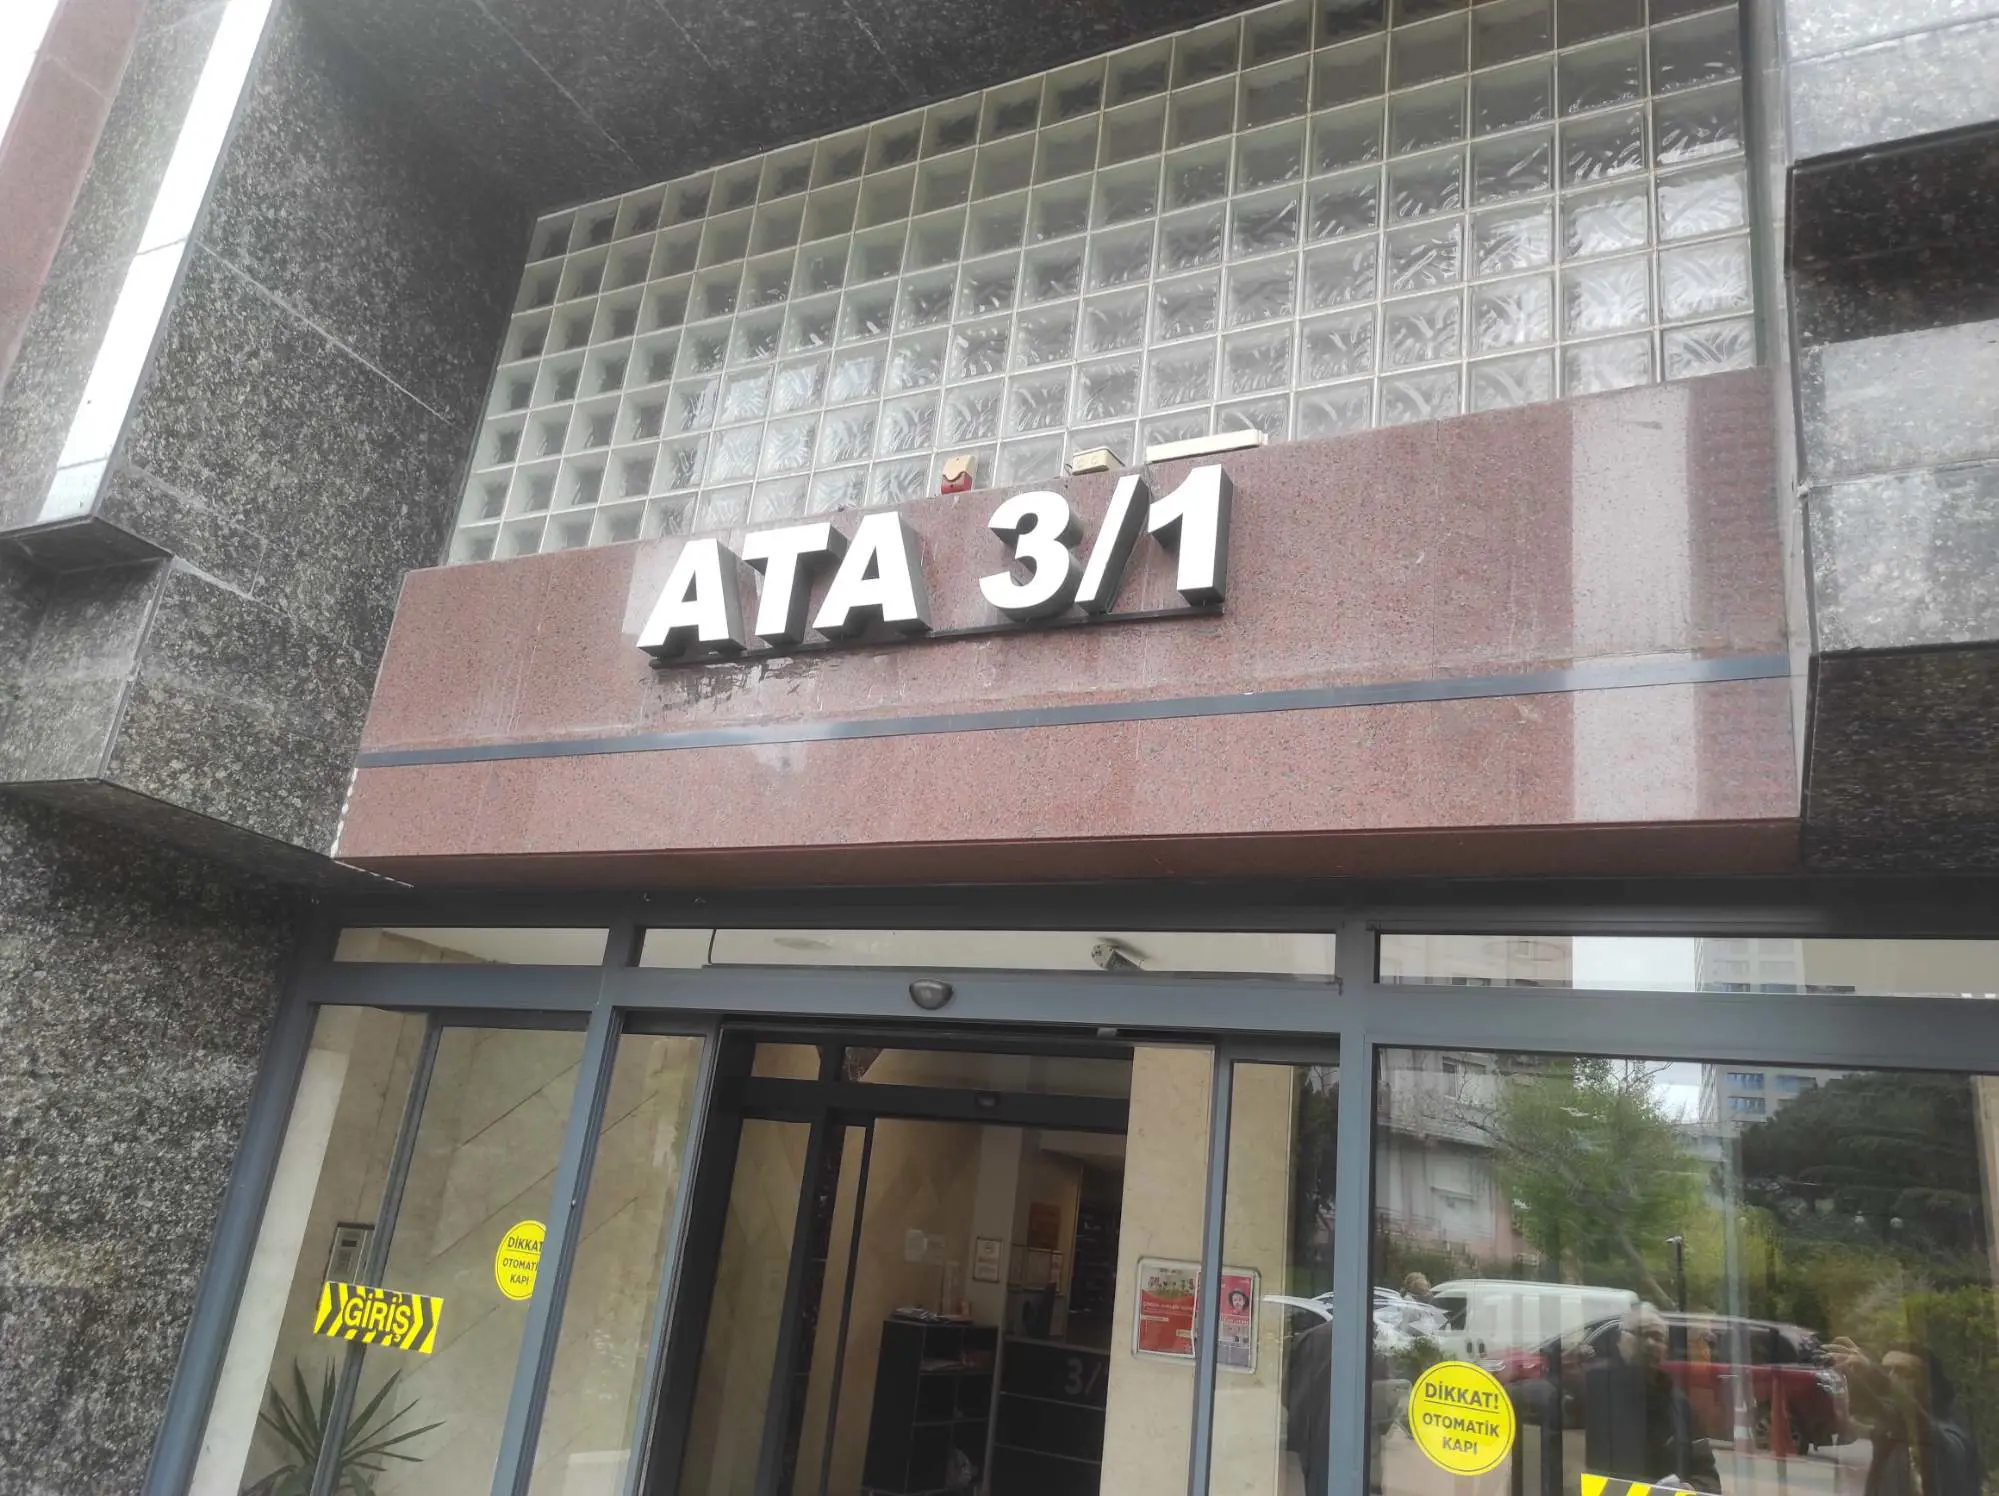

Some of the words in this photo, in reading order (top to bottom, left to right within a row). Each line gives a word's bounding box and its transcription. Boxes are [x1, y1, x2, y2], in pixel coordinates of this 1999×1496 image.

[637, 511, 922, 652] ATA
[979, 464, 1225, 615] 3/1
[509, 1273, 530, 1286] KAPI
[343, 1292, 411, 1343] GİRİŞ
[1424, 1381, 1499, 1410] DİKKAT!
[1422, 1412, 1500, 1438] OTOMATİK
[1442, 1437, 1477, 1455] KAPI
